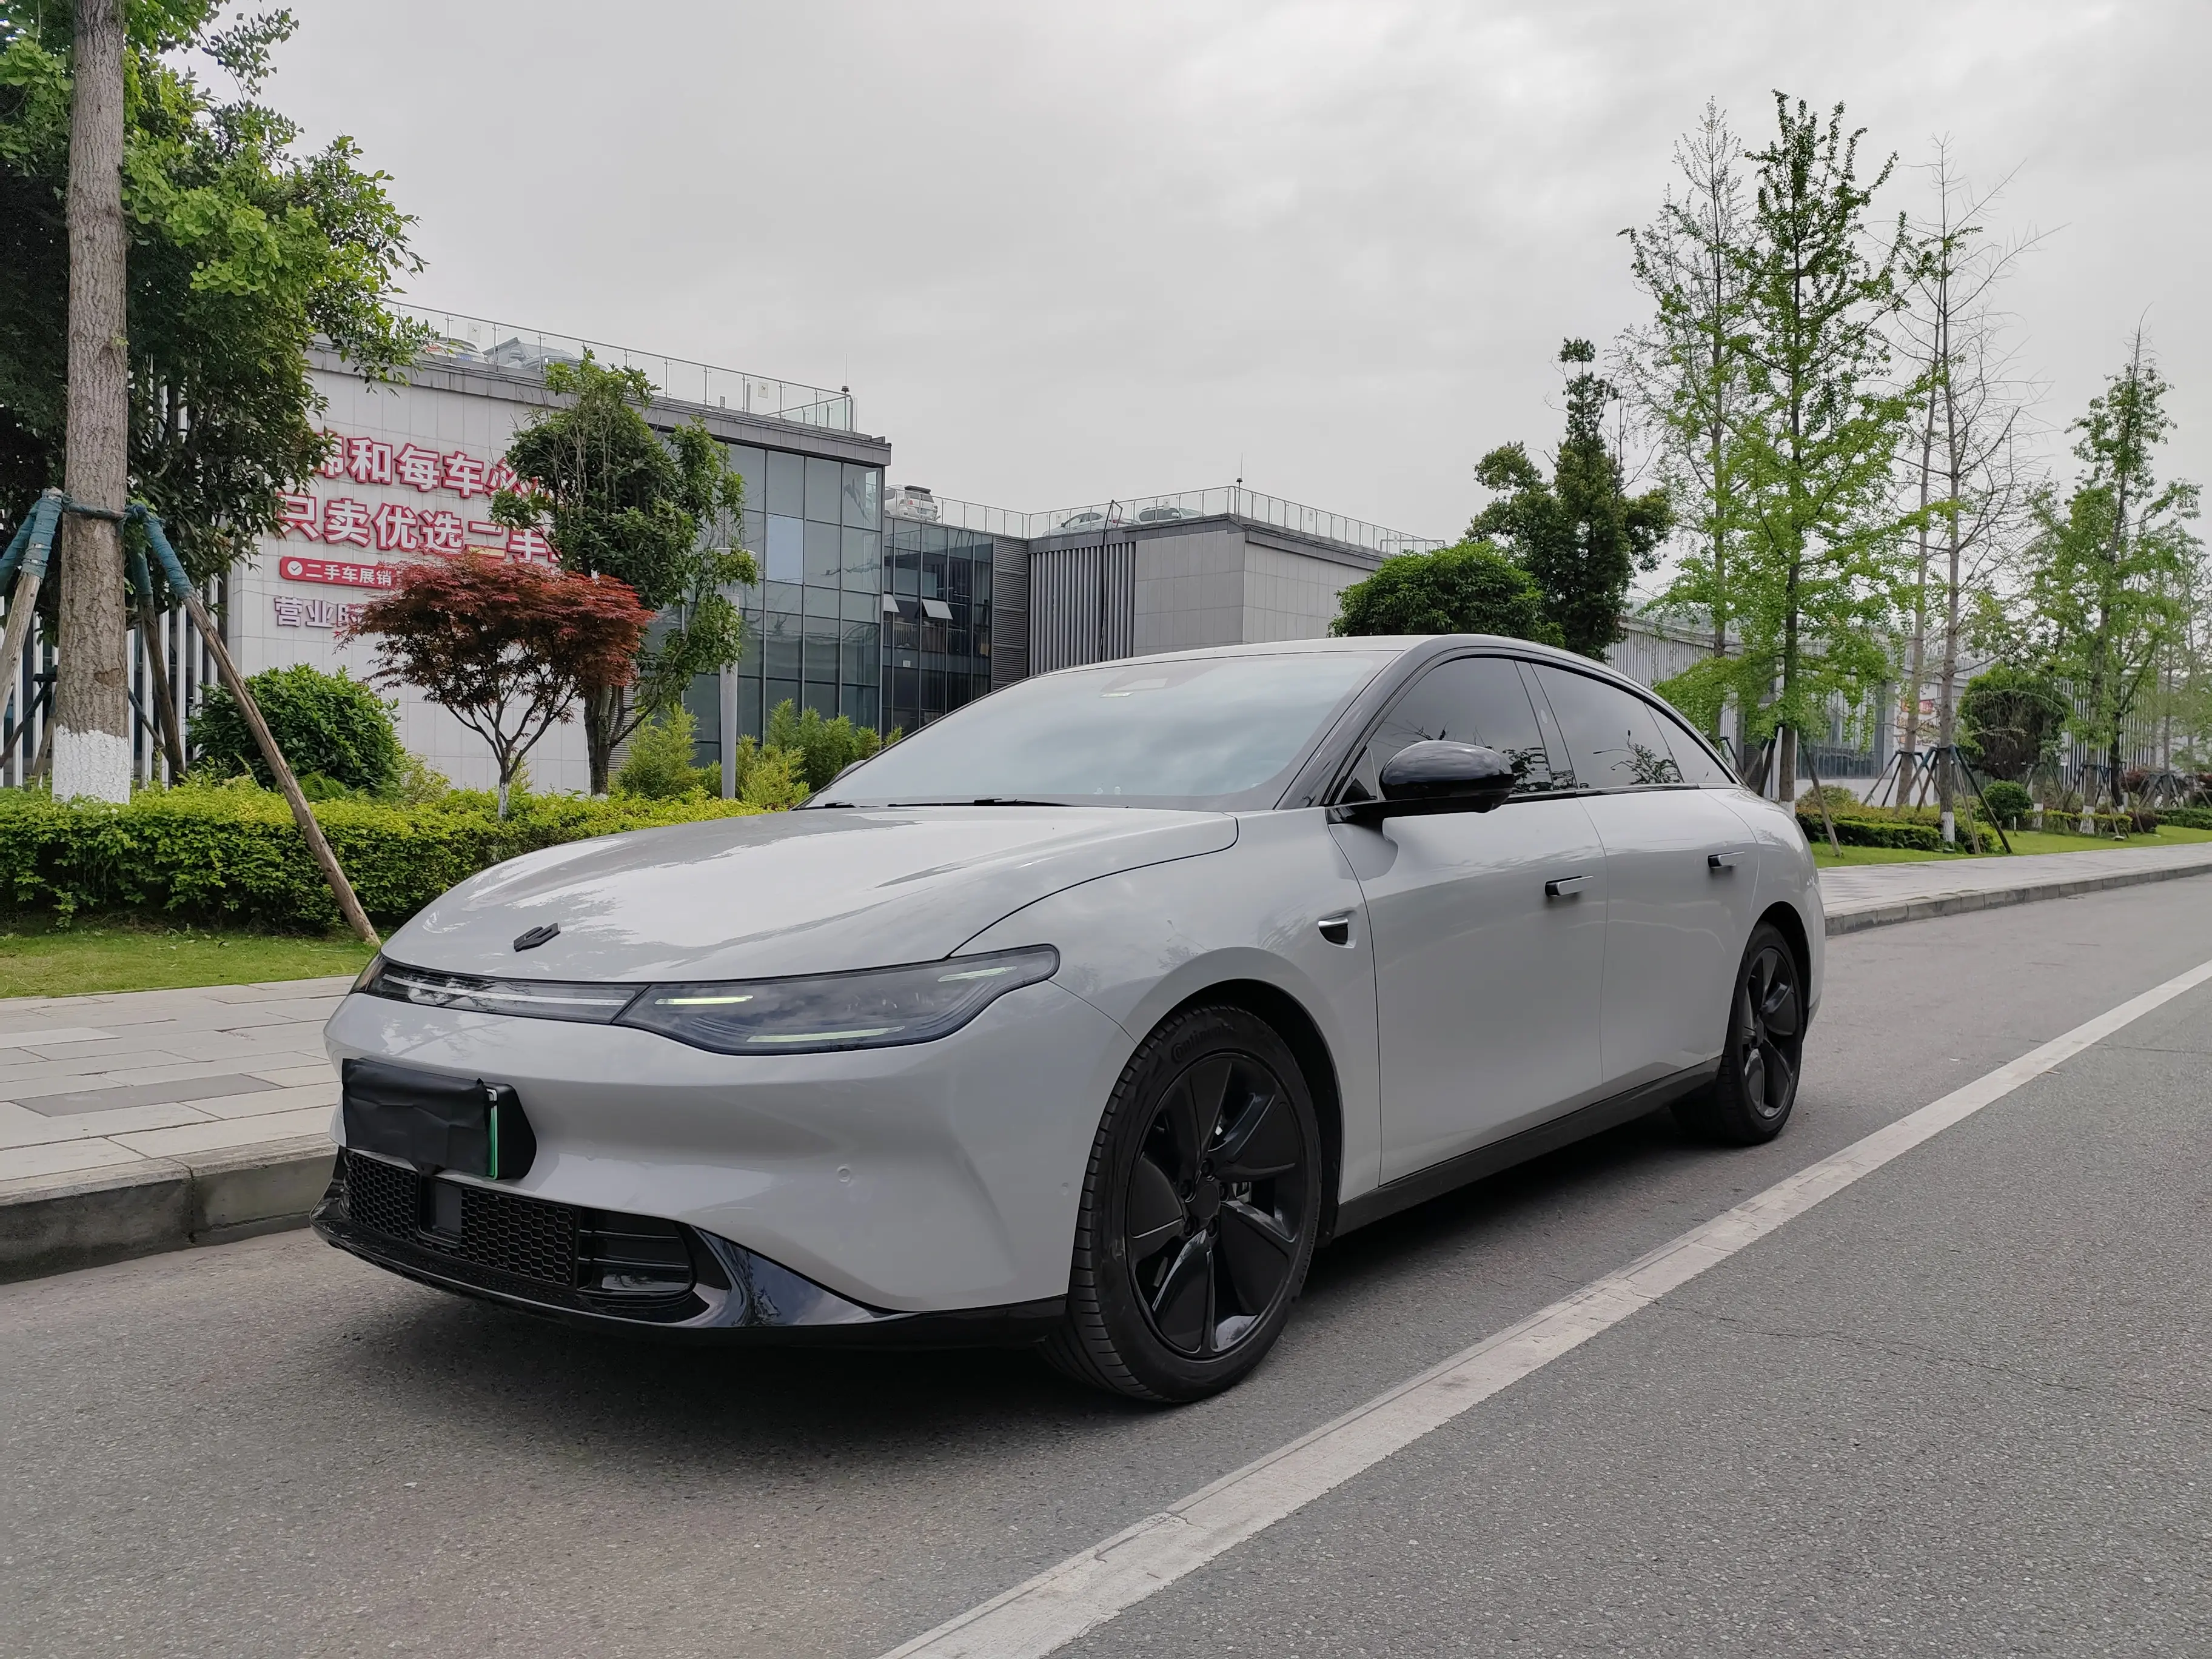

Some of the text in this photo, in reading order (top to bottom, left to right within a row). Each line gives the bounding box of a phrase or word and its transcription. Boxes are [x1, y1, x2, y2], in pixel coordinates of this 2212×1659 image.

[306, 563, 392, 586] 二手车展销
